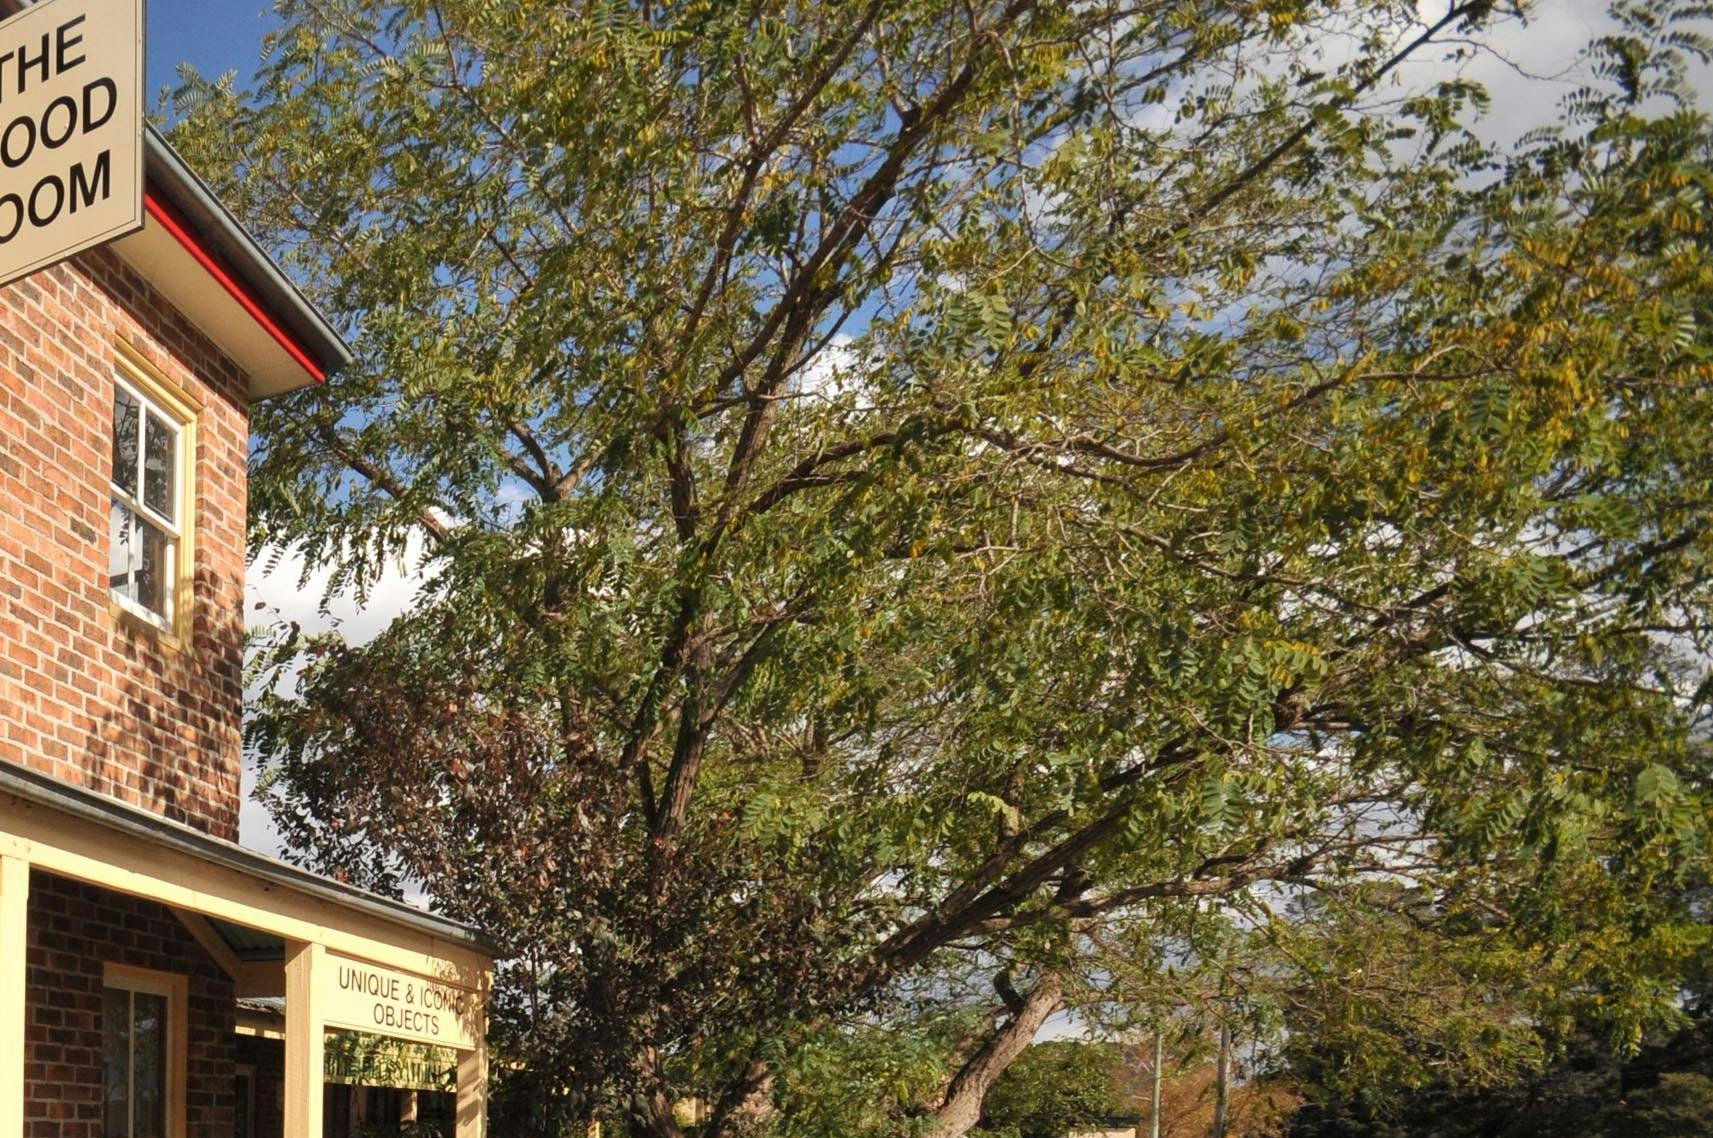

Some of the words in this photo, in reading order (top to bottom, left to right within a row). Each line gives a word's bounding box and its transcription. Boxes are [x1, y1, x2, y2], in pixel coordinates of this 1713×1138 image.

[339, 966, 400, 1001] UNIQUE
[405, 983, 415, 1004] &
[420, 986, 464, 1016] ICONIC
[373, 1003, 440, 1036] OBJECTS
